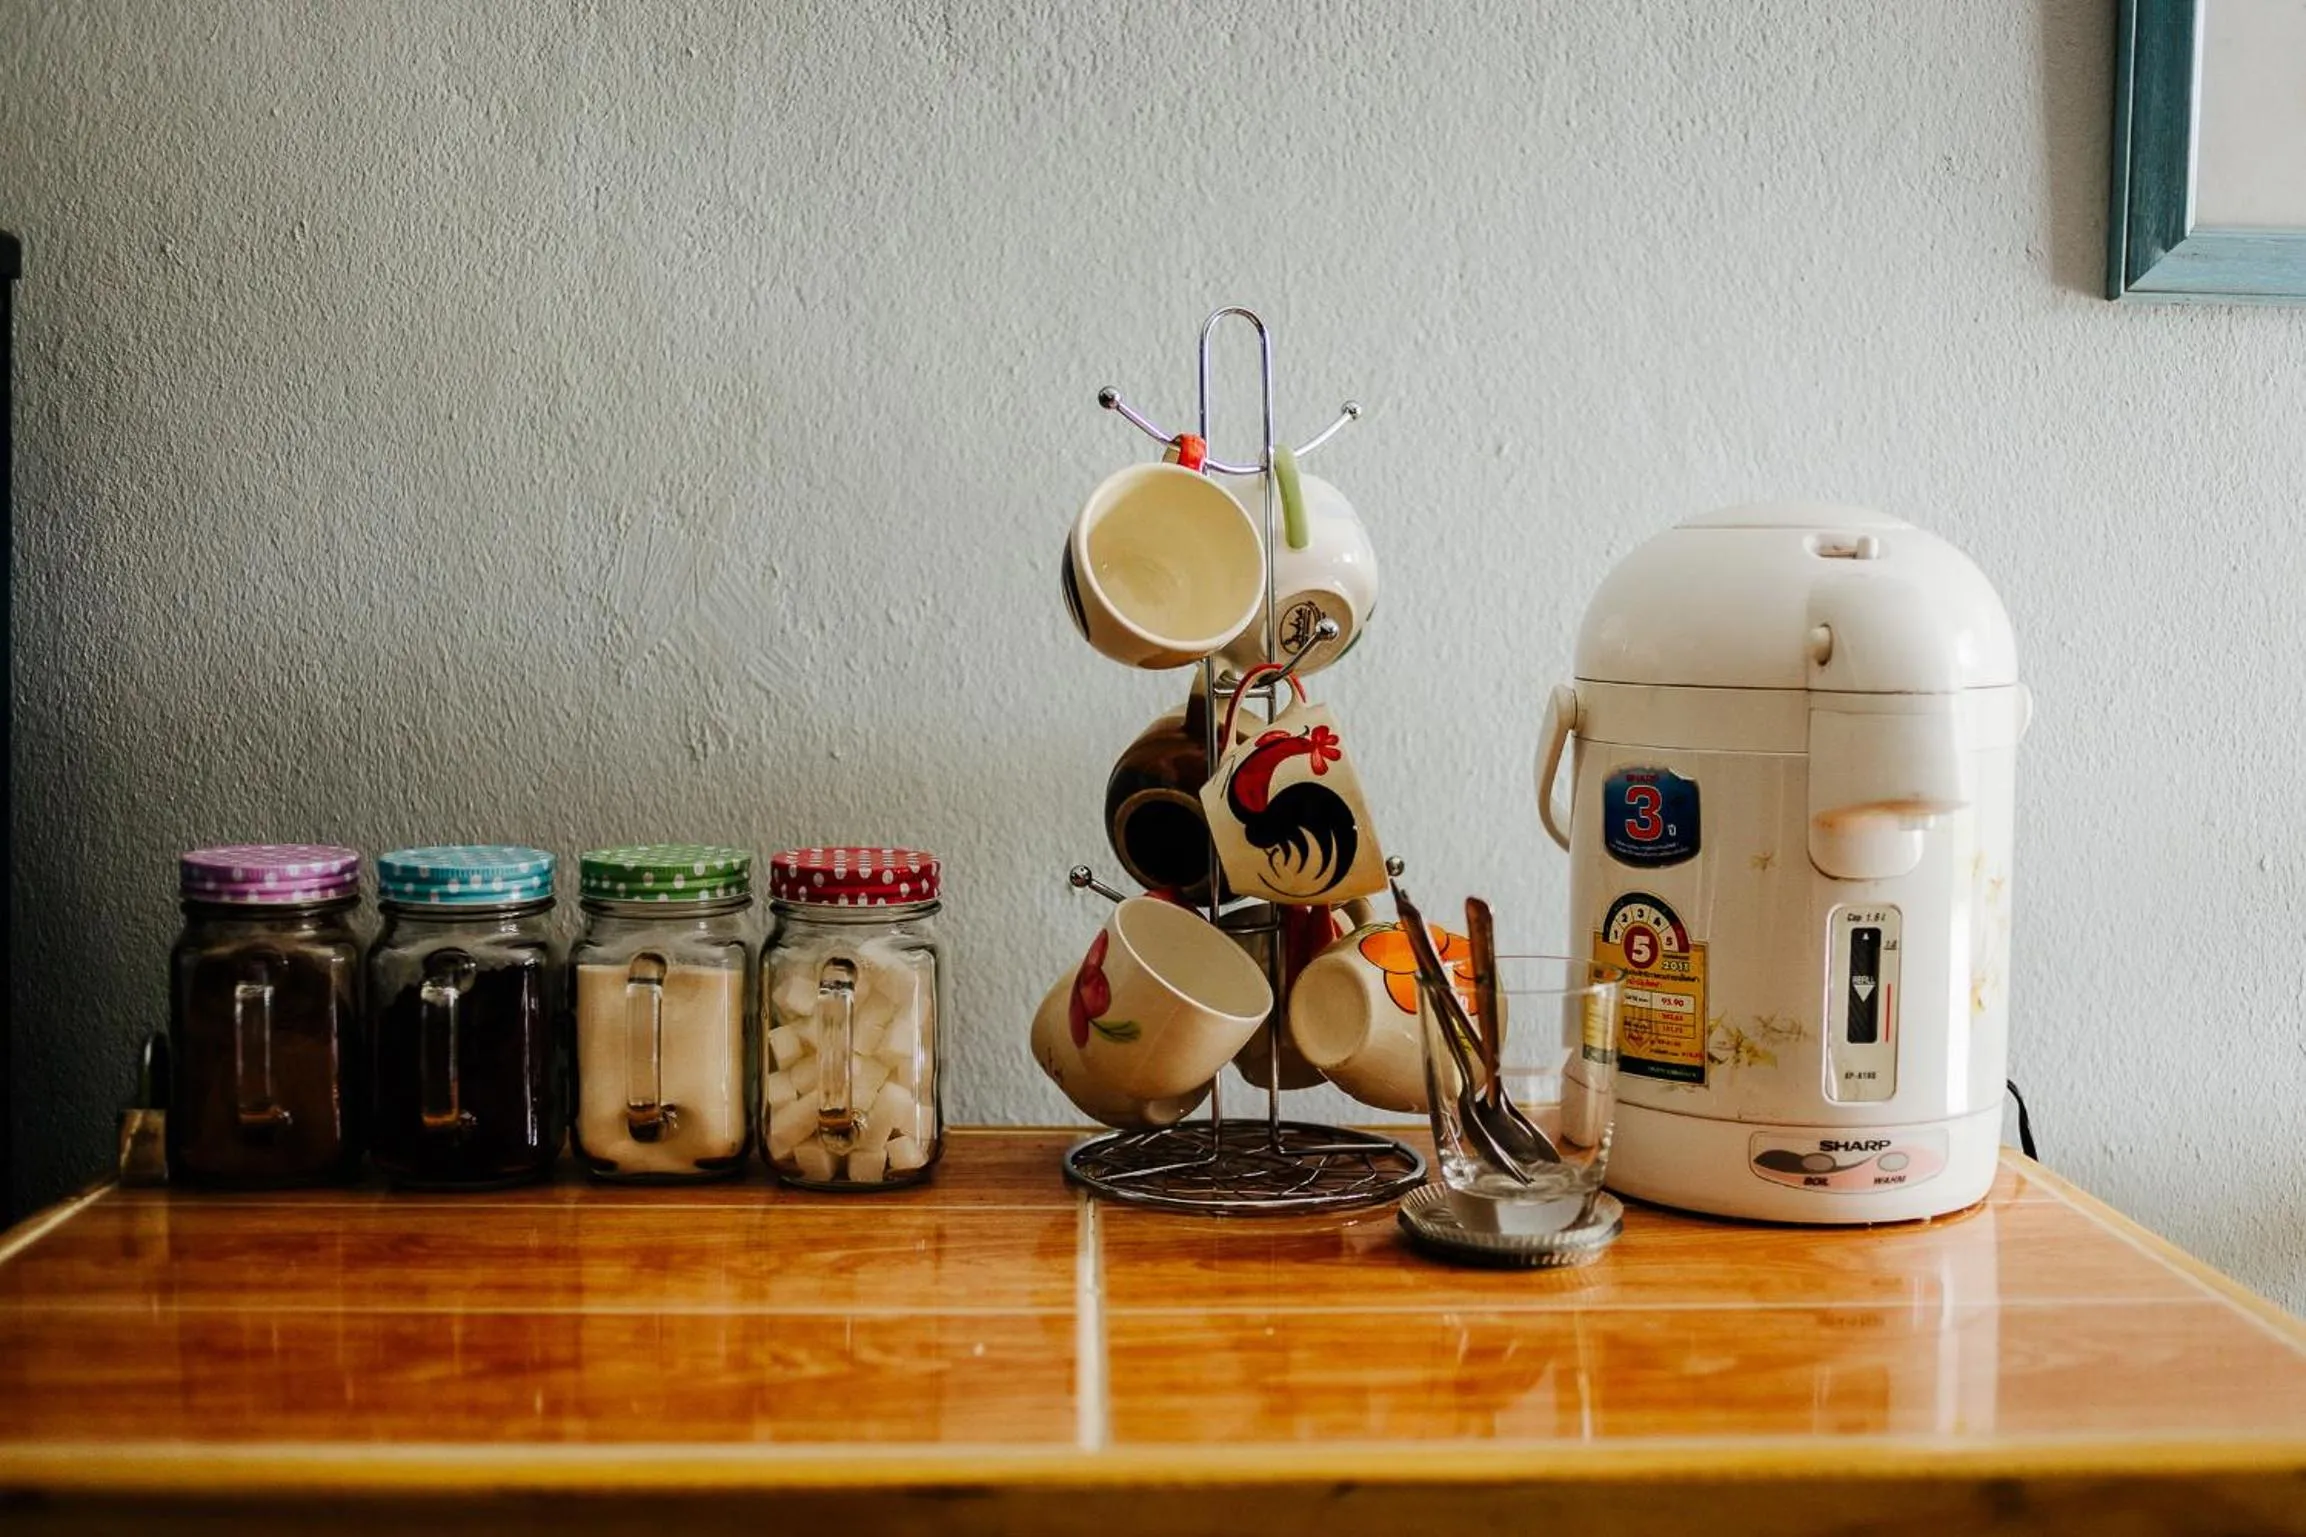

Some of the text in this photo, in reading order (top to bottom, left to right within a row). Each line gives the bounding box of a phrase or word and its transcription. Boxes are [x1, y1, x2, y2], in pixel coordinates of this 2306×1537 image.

[1625, 784, 1663, 841] 3
[1621, 913, 1628, 922] 2
[1637, 908, 1644, 918] 3
[1653, 917, 1661, 927] 4
[1666, 936, 1673, 946] 5
[1632, 935, 1651, 963] 5
[1819, 1139, 1891, 1151] SHARP
